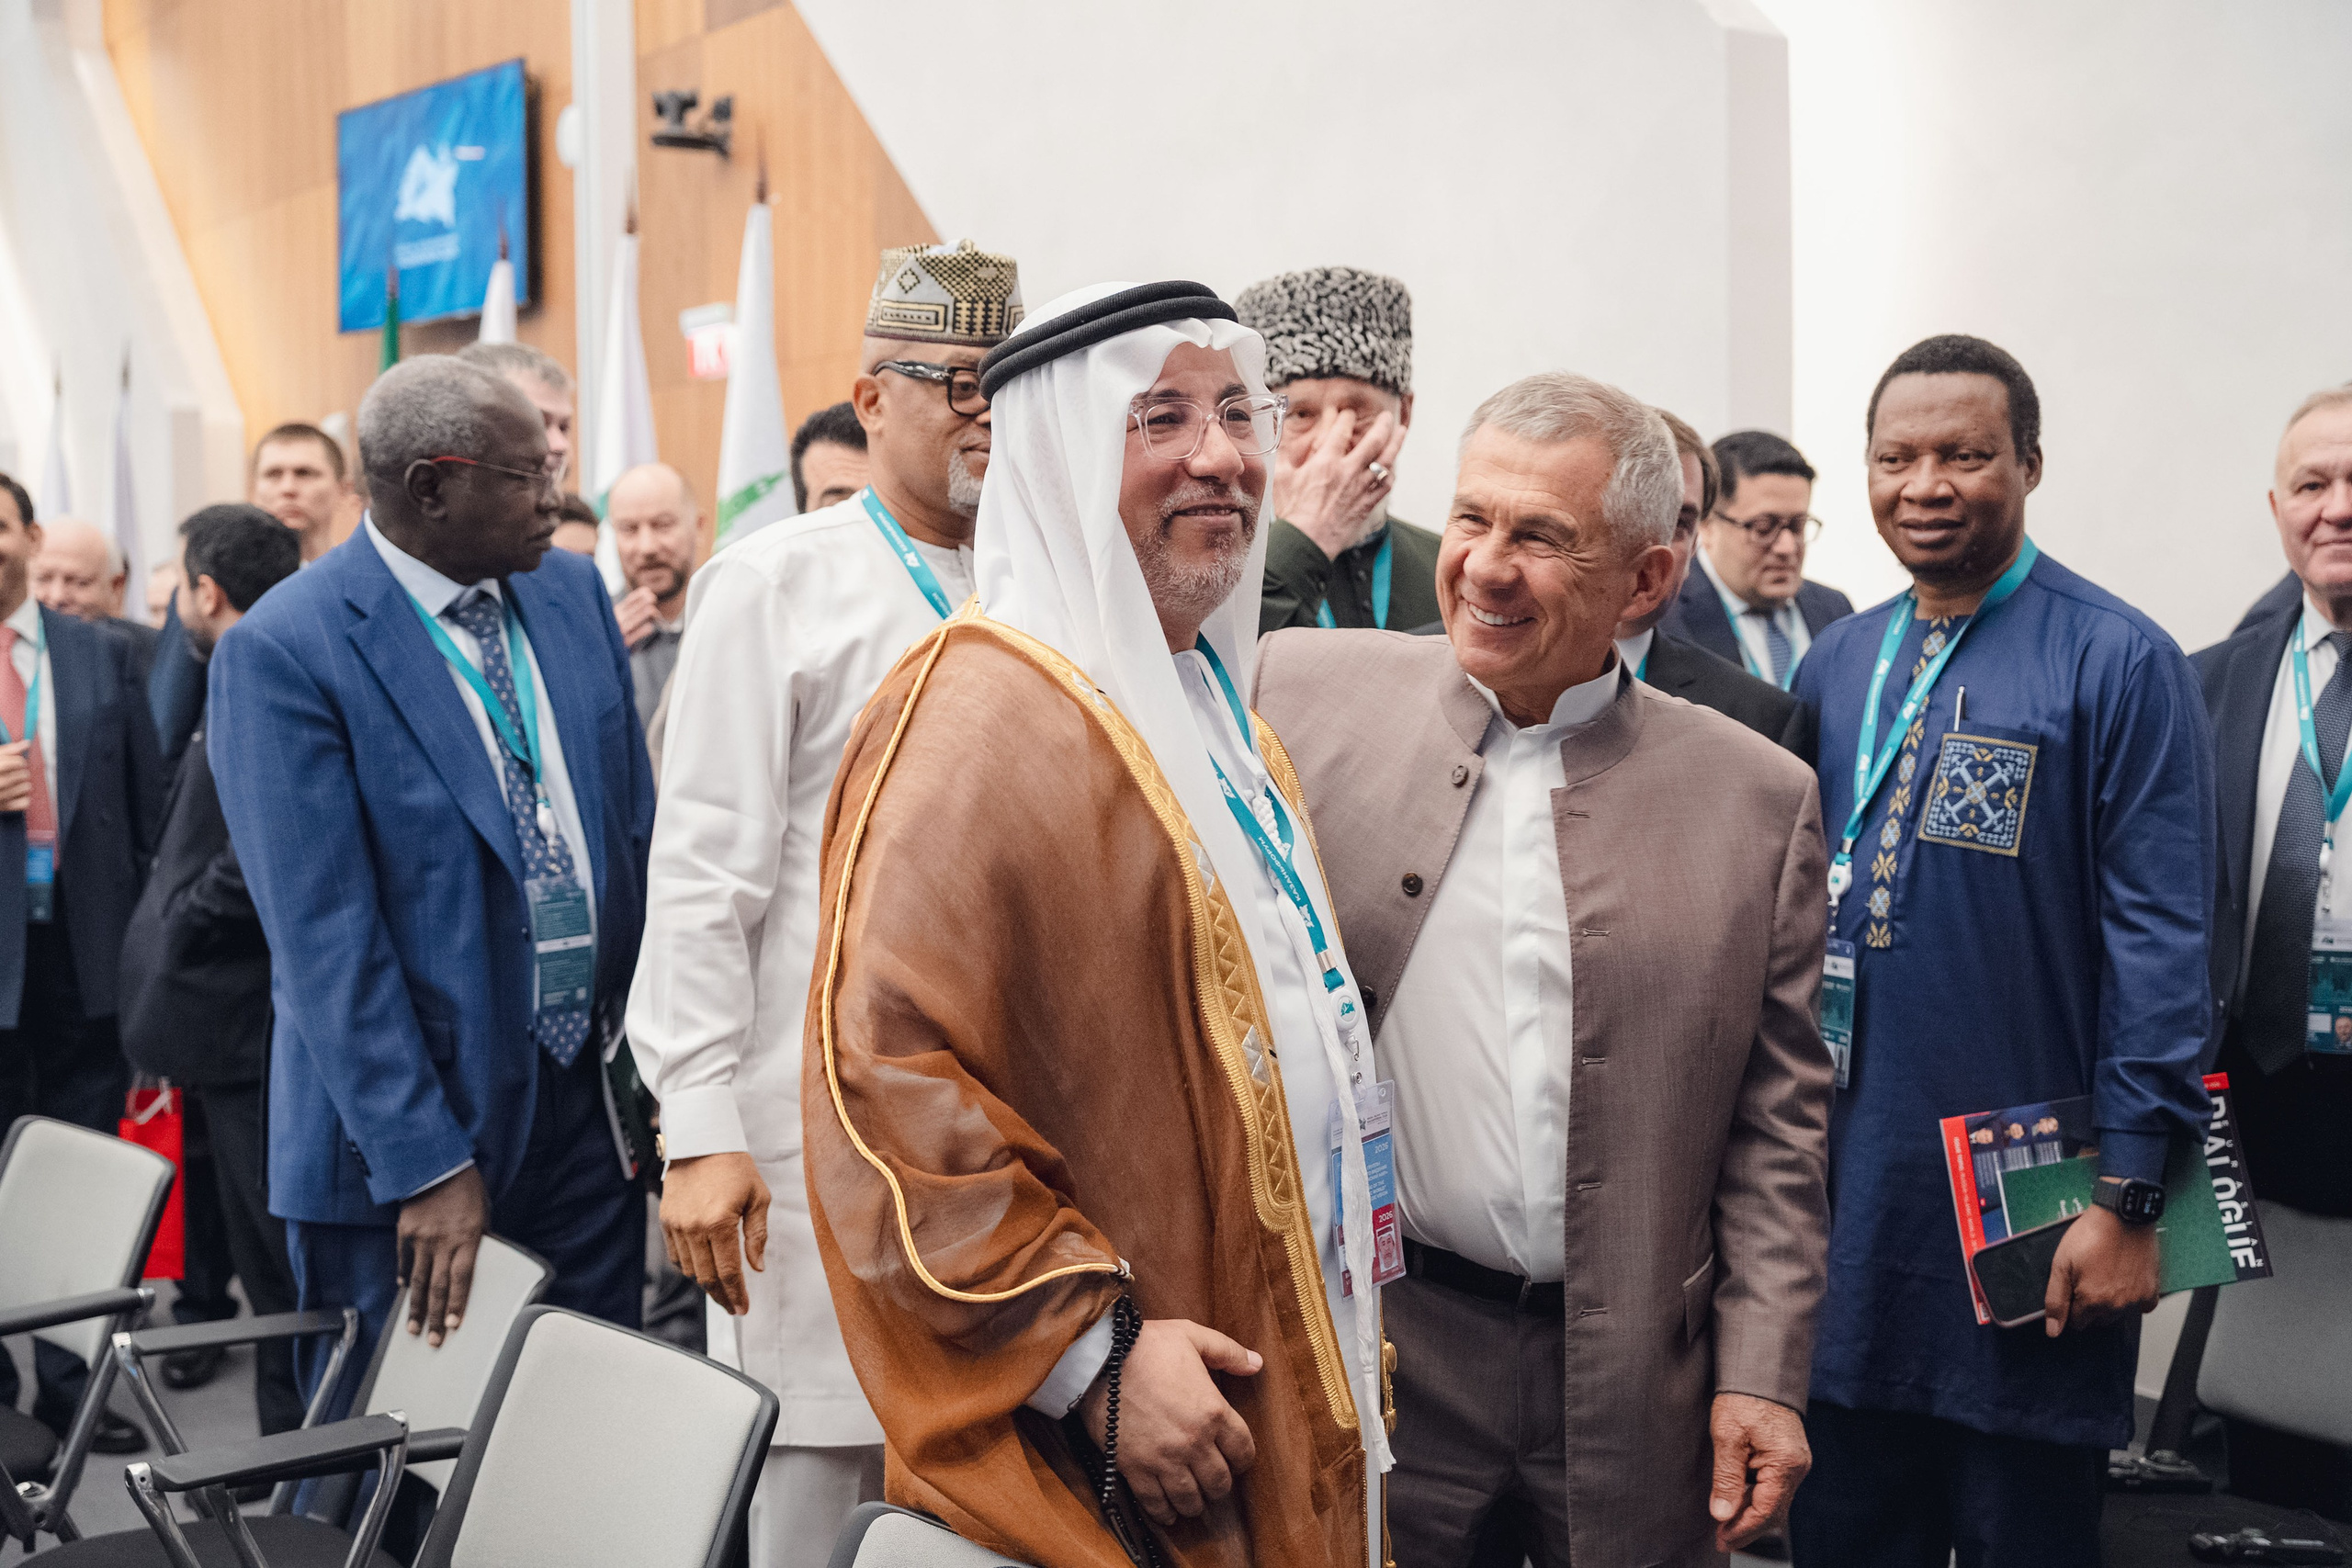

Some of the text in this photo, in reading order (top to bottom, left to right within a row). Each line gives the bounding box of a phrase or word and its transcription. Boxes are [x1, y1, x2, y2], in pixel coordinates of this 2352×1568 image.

[1258, 836, 1301, 902] КАЗАНЬФОРУМ
[1374, 1142, 1389, 1154] 2026
[2222, 1120, 2264, 1268] EURASIAN
[1378, 1210, 1394, 1223] 2026
